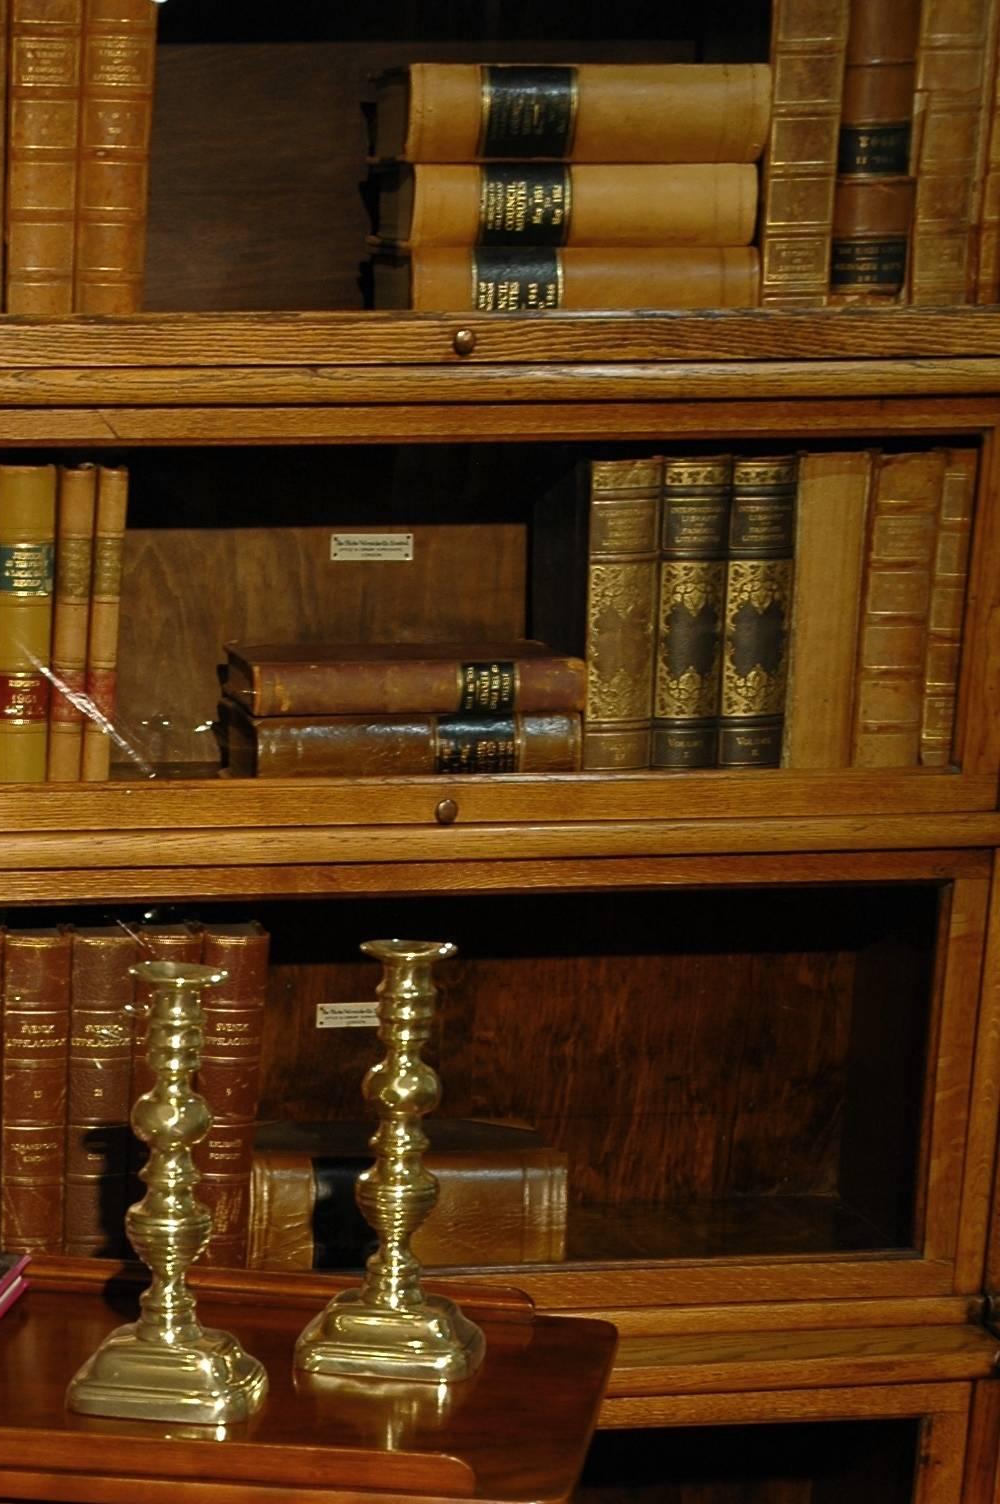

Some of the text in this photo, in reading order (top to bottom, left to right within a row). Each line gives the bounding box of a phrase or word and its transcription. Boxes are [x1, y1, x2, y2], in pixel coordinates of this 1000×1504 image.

[505, 182, 516, 231] COUNCIL
[516, 181, 527, 231] MINUTES
[205, 1036, 260, 1046] PPSLAGSBOK
